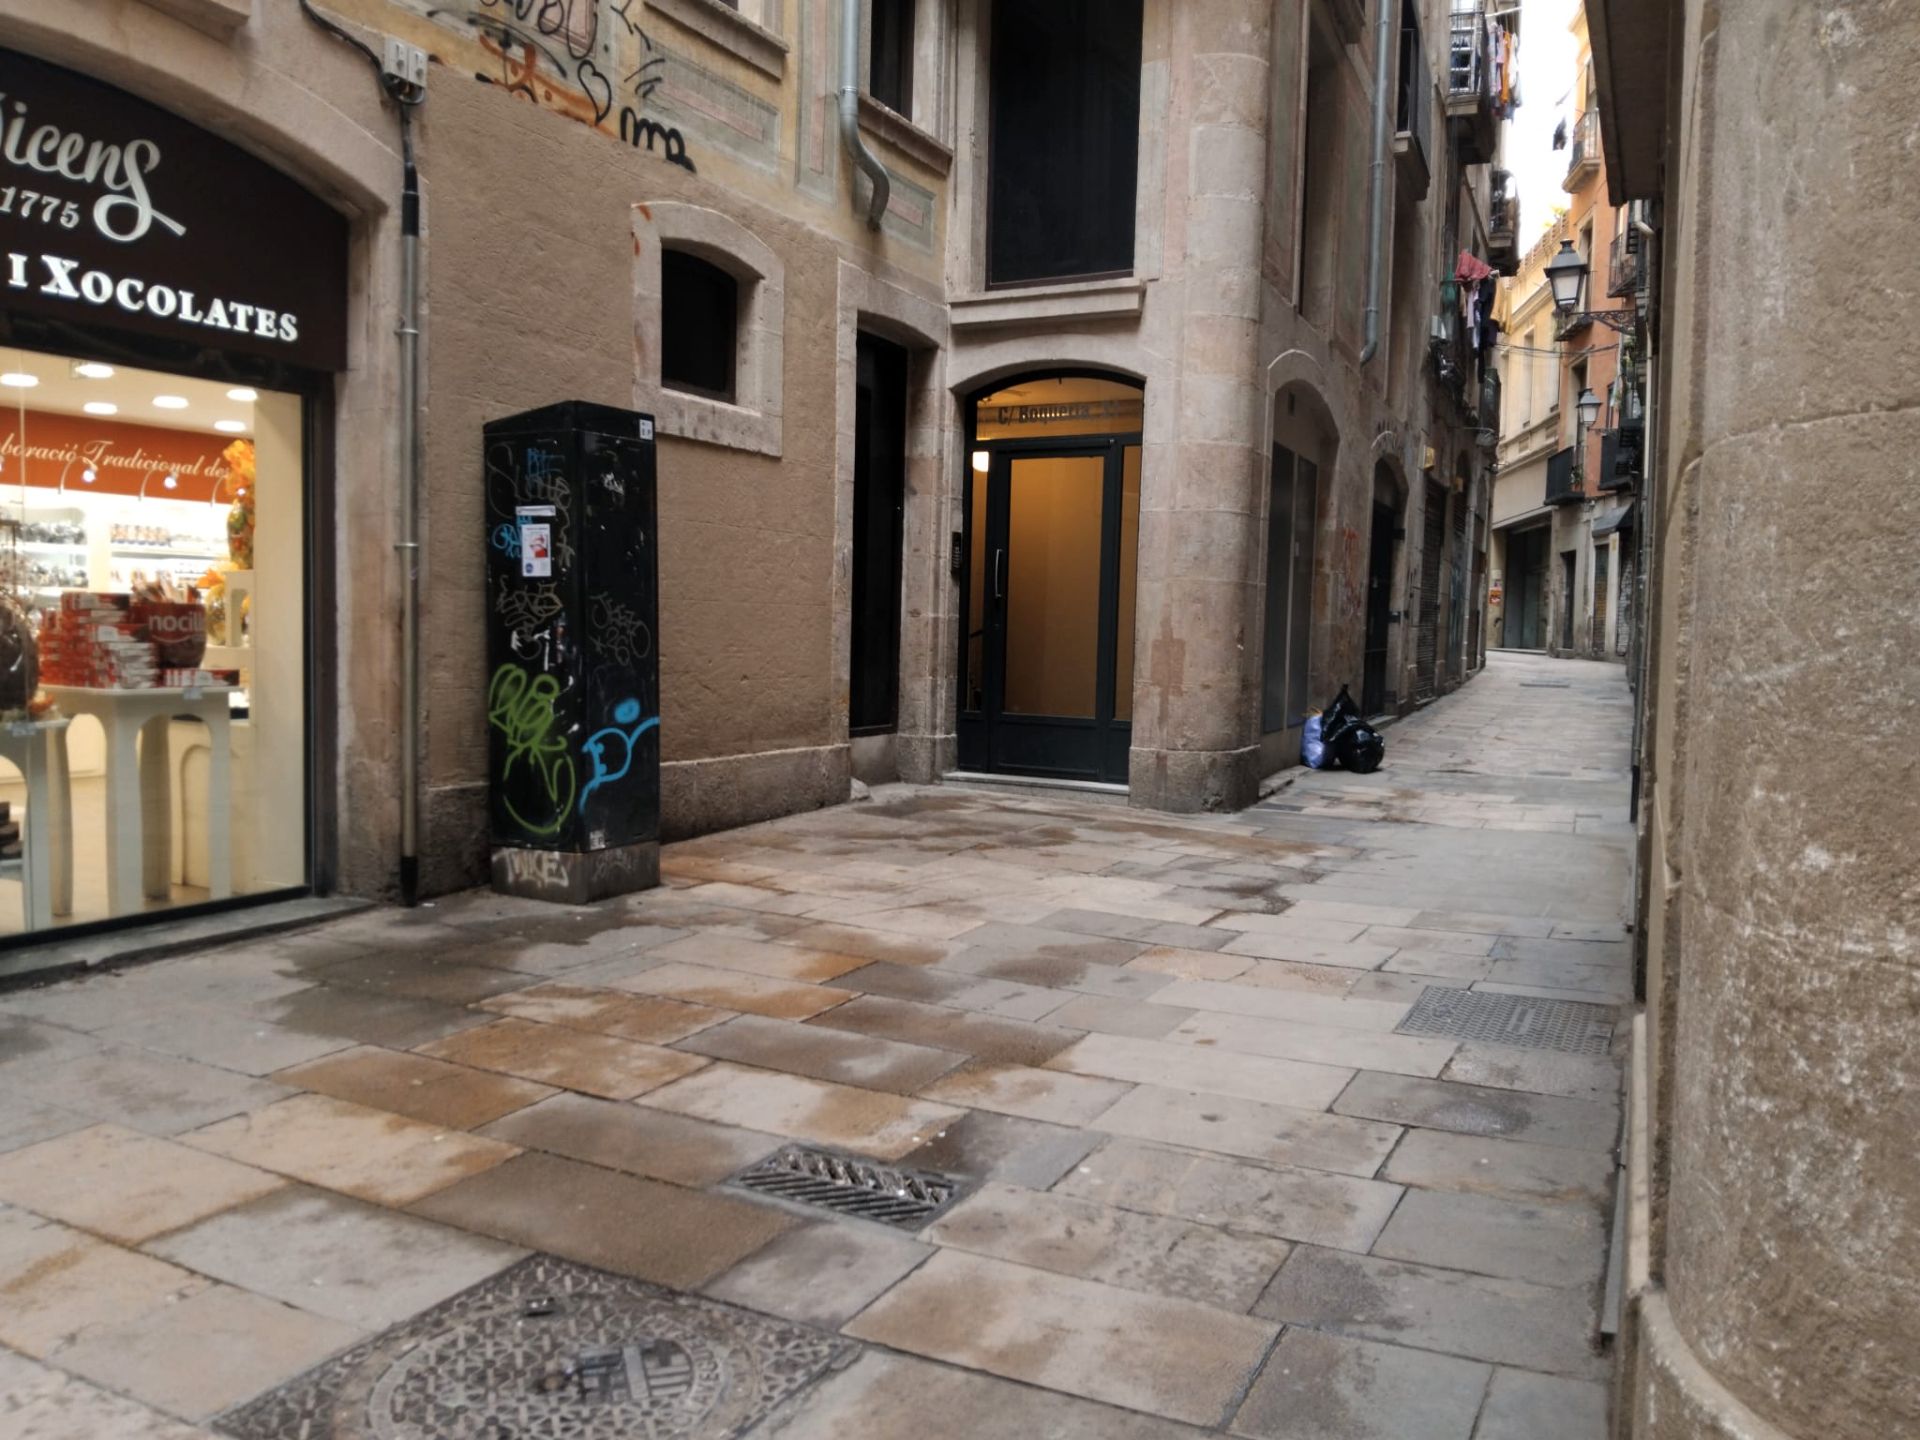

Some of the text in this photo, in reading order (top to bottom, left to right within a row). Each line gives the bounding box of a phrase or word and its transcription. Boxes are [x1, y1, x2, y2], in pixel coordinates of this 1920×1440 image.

[0, 92, 187, 243] icens
[0, 186, 80, 229] 1775
[8, 252, 29, 288] I
[0, 433, 78, 463] boració
[83, 439, 205, 477] Tradicional
